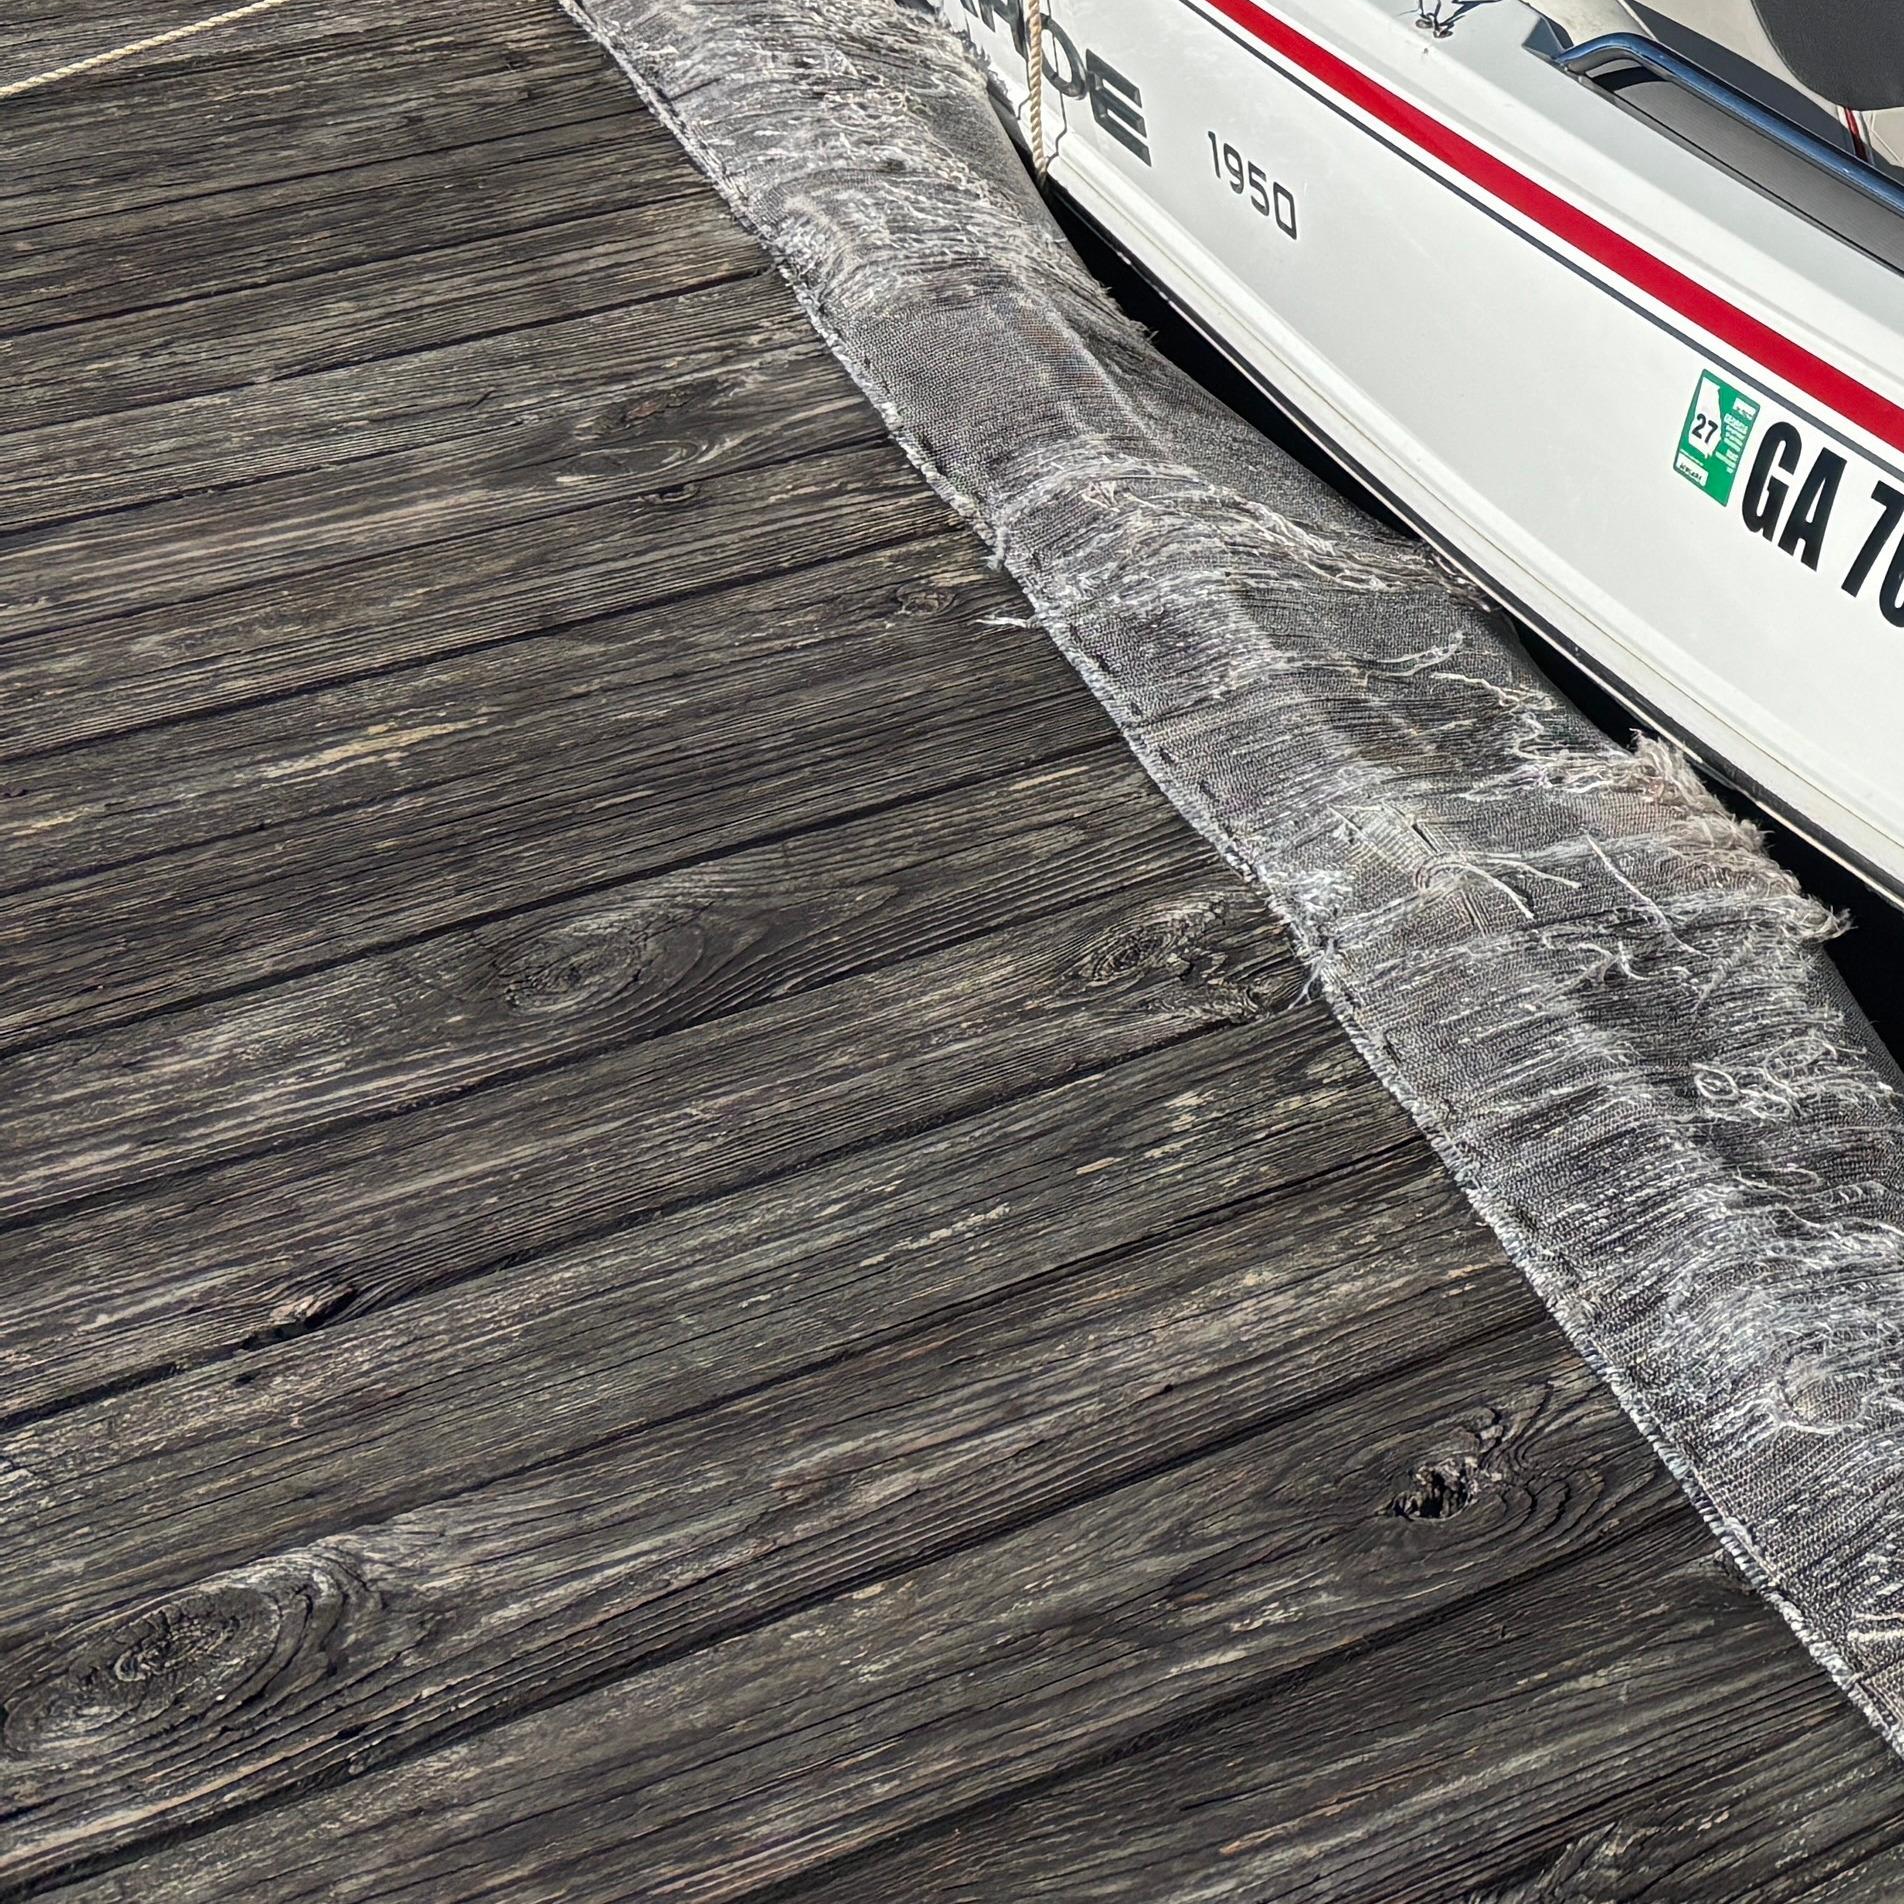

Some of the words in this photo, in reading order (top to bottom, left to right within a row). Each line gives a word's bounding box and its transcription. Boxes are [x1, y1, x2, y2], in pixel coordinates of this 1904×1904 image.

[1208, 130, 1299, 241] 1950
[1692, 413, 1719, 444] 27
[1741, 421, 1848, 572] GA
